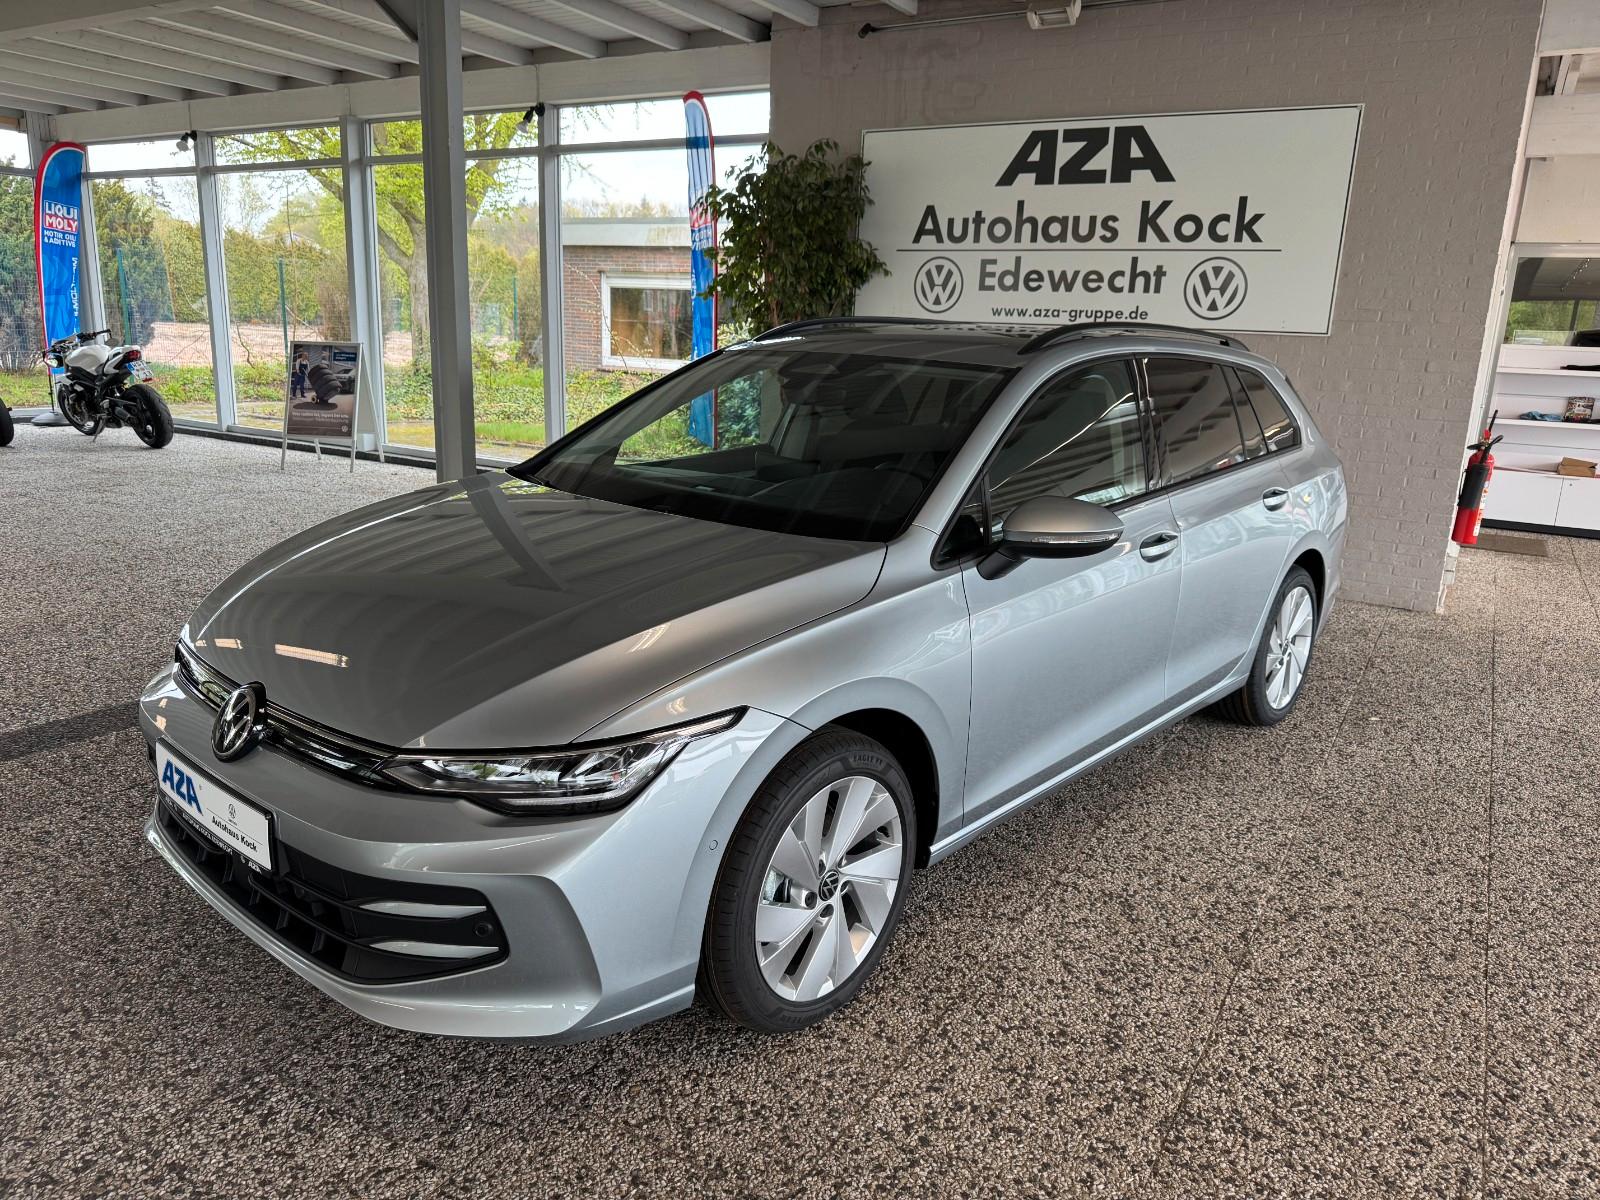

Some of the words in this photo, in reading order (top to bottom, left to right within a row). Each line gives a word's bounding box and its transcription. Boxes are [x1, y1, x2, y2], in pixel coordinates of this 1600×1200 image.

[995, 125, 1176, 187] AZA
[45, 201, 78, 220] LIQUI
[45, 214, 78, 232] MOLY
[911, 200, 1120, 245] Autohaus
[1137, 195, 1266, 244] Kock
[978, 256, 1167, 294] Edewecht
[991, 306, 1149, 324] www.aza-gruppe.de
[162, 759, 204, 816] AZA
[211, 815, 240, 841] Autohaus
